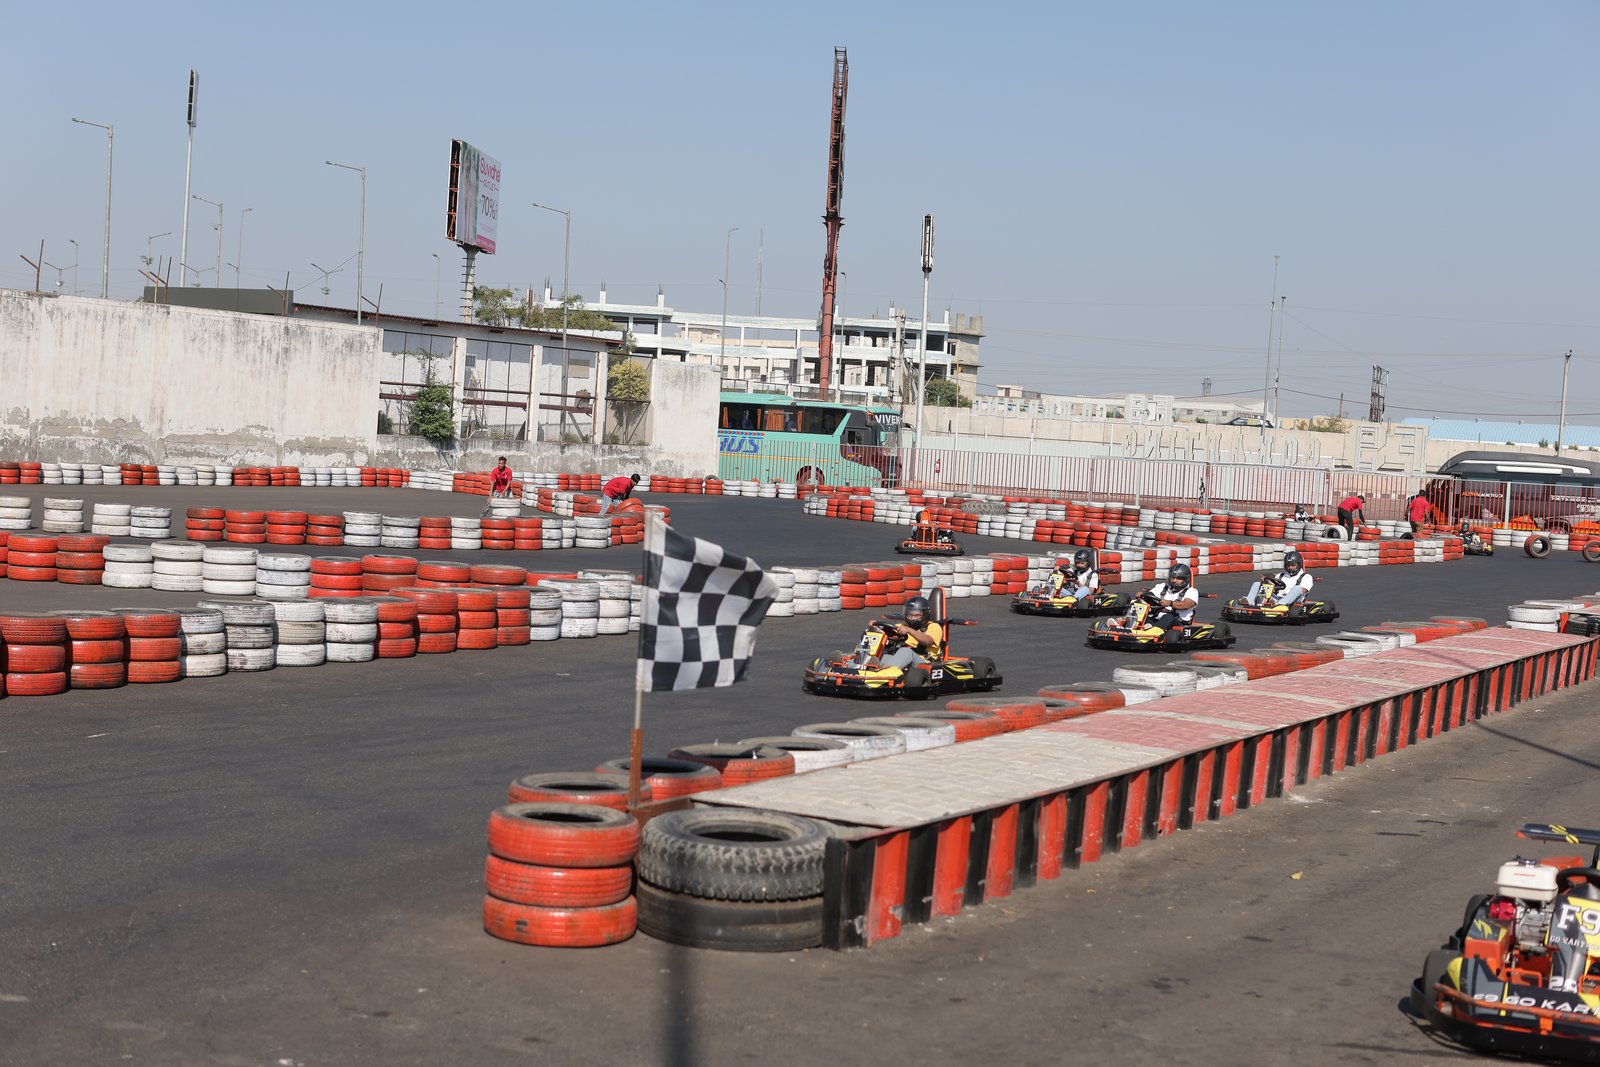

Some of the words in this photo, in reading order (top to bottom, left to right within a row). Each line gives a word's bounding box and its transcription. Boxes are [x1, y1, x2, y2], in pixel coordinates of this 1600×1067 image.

[1184, 629, 1191, 637] 31
[860, 634, 879, 647] F9
[931, 669, 943, 680] 23
[1556, 903, 1600, 935] F9
[1505, 995, 1536, 1007] GO
